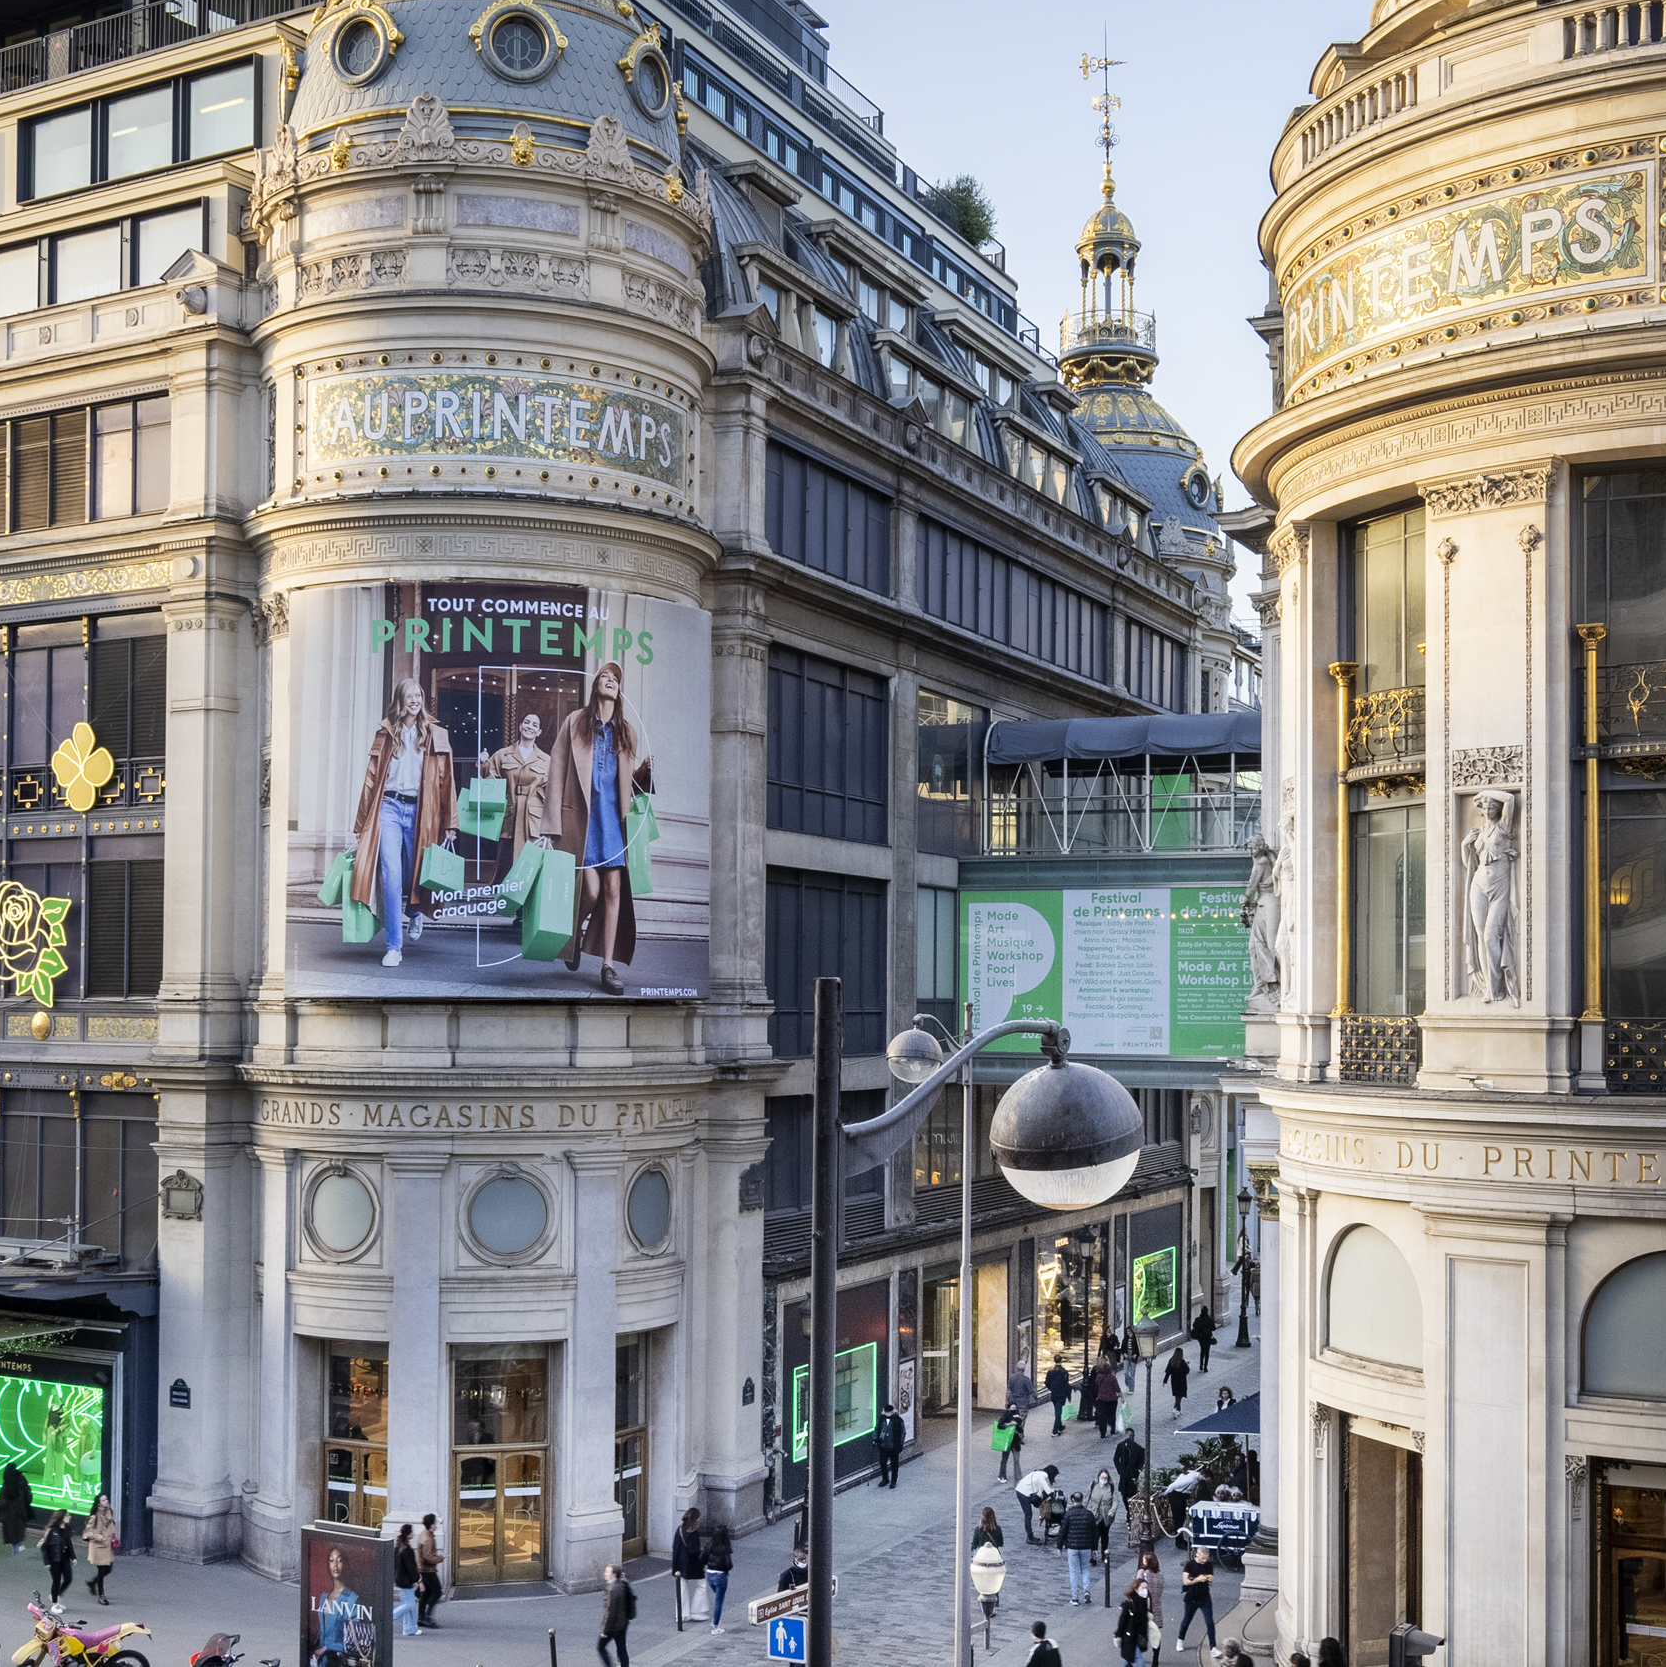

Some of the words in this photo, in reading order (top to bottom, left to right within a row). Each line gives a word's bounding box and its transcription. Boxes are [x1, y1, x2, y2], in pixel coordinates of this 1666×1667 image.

[1288, 199, 1612, 366] PRINTEMPS
[330, 392, 389, 445] AU
[404, 390, 672, 469] PRINTEMPS
[428, 598, 475, 612] TOUT
[481, 599, 583, 619] COMMENCE
[588, 607, 610, 621] AU
[371, 616, 654, 666] PRINTEMPS
[431, 889, 463, 904] Mon
[467, 879, 525, 902] premier
[1091, 891, 1142, 904] Festival
[433, 898, 507, 920] craquage
[987, 910, 1019, 921] Mode
[1073, 906, 1090, 918] de
[1093, 905, 1160, 919] Printemps
[1180, 905, 1198, 918] de
[1201, 905, 1242, 917] Printe
[987, 924, 1004, 934] Art
[972, 910, 983, 966] Printemps
[987, 937, 1034, 949] Musique
[1077, 945, 1113, 953] Happening
[1225, 941, 1244, 949] Gracy
[987, 950, 1044, 962] Workshop
[987, 964, 1015, 974] Food
[1177, 961, 1212, 972] Mode
[1217, 961, 1237, 972] Art
[972, 971, 981, 984] de
[986, 977, 1015, 987] Lives
[1177, 974, 1240, 987] Workshop
[640, 987, 698, 997] PRINTEMPS.COM
[1109, 995, 1125, 1003] Yoga
[972, 987, 981, 1030] Festival
[1021, 1004, 1033, 1013] 19
[1117, 1003, 1143, 1011] Gaming
[1021, 1030, 1042, 1039] 202
[260, 1099, 343, 1126] GRANDS
[363, 1103, 536, 1129] MAGASINS
[558, 1103, 597, 1128] DU
[1396, 1140, 1441, 1172] DU
[461, 1386, 542, 1400] PRINTEMPS
[311, 1596, 373, 1621] LANVIN
[778, 1599, 791, 1611] SAINT
[793, 1594, 805, 1606] LOUIS
